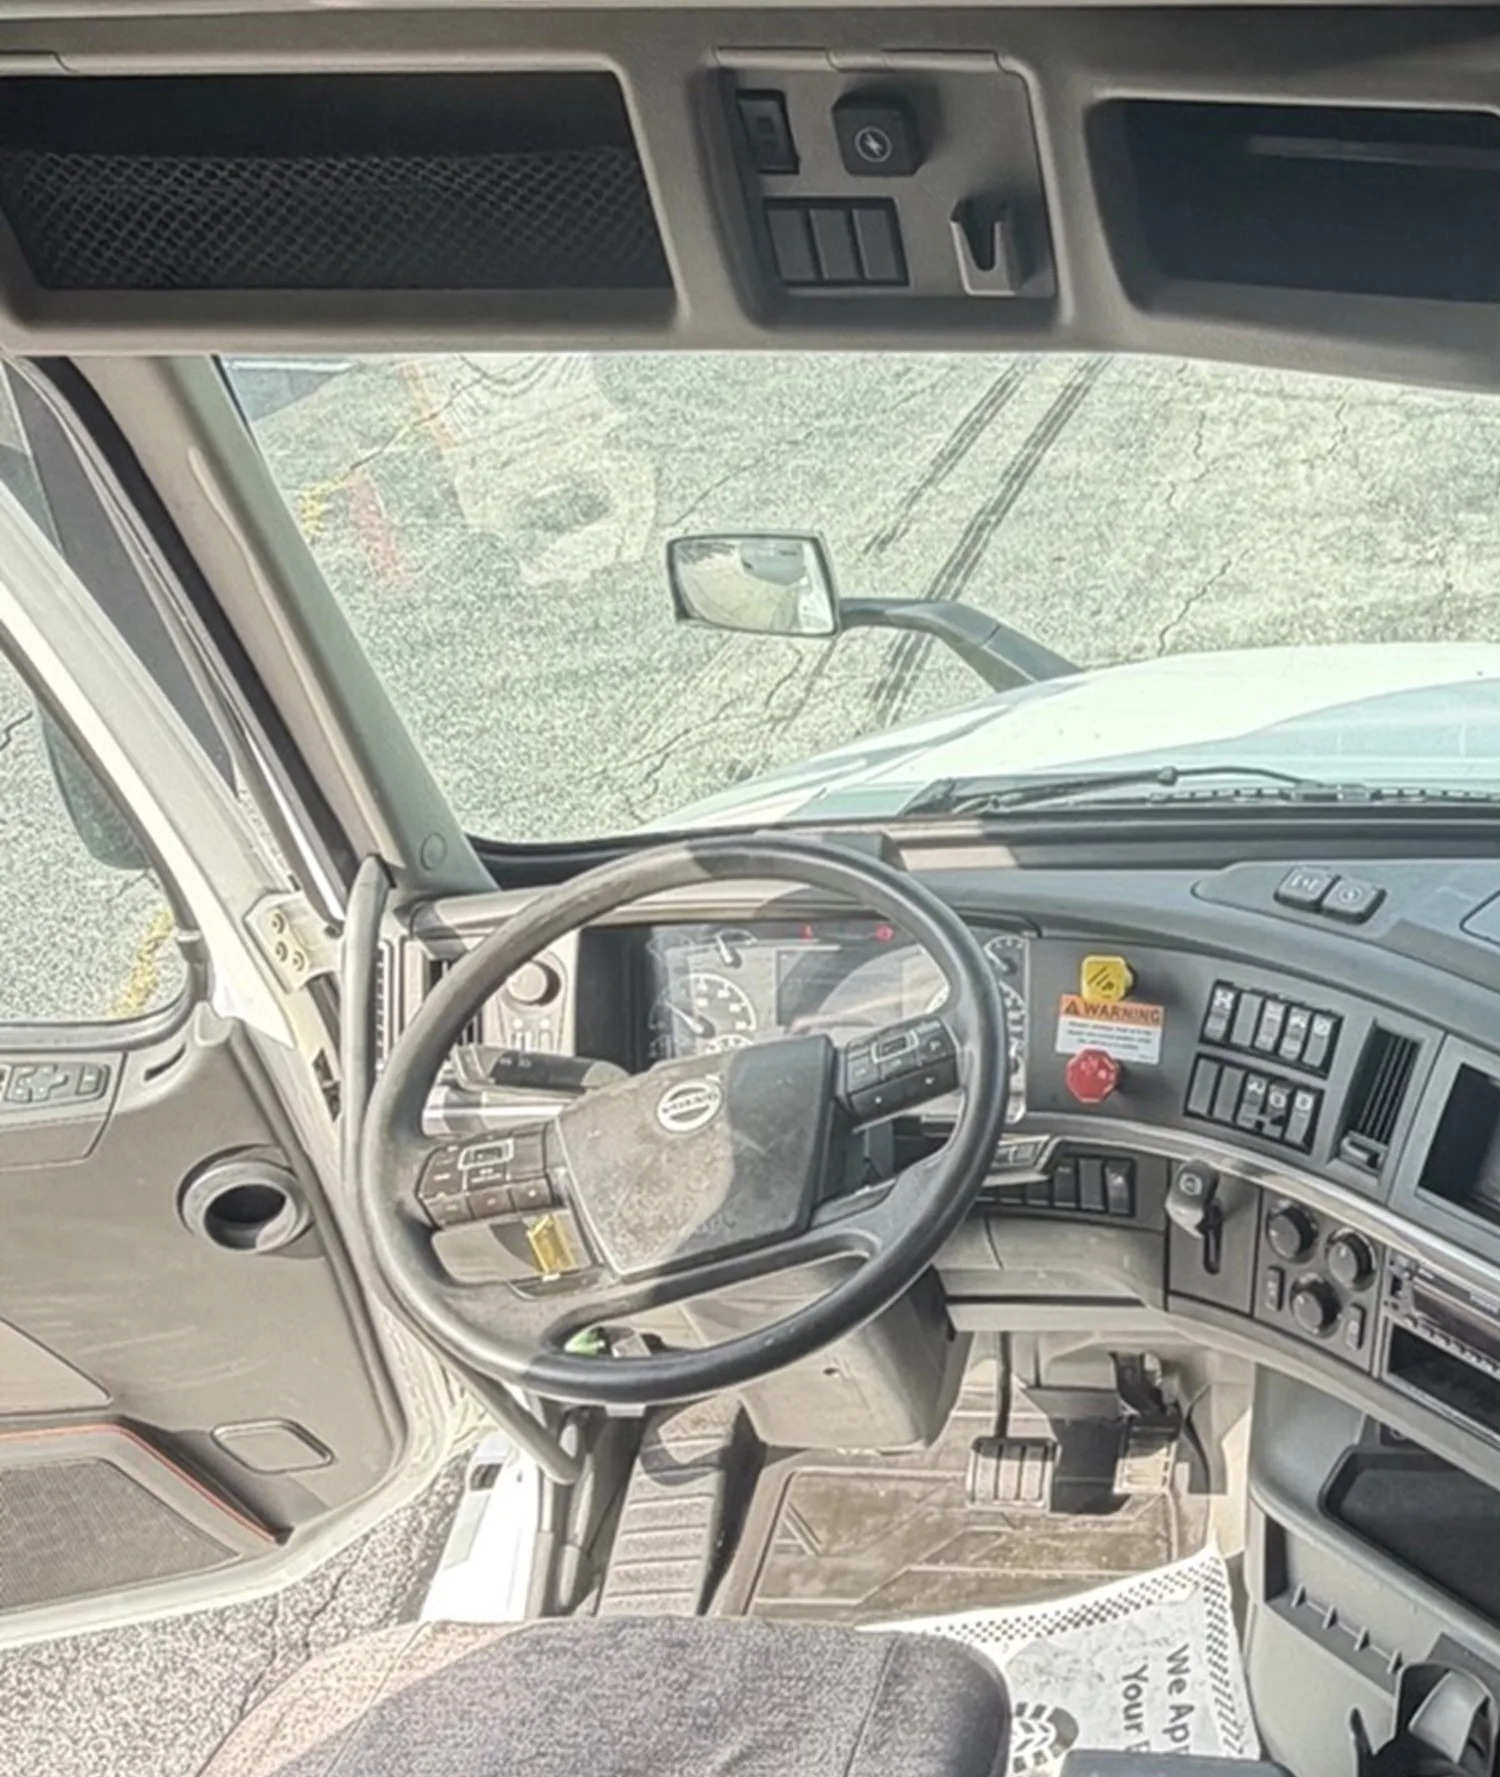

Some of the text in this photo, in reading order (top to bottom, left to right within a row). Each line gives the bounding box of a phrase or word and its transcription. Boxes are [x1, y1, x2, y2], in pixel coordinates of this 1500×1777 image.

[1083, 1001, 1160, 1022] WARNING
[1166, 1643, 1191, 1696] We
[1121, 1663, 1149, 1733] Your
